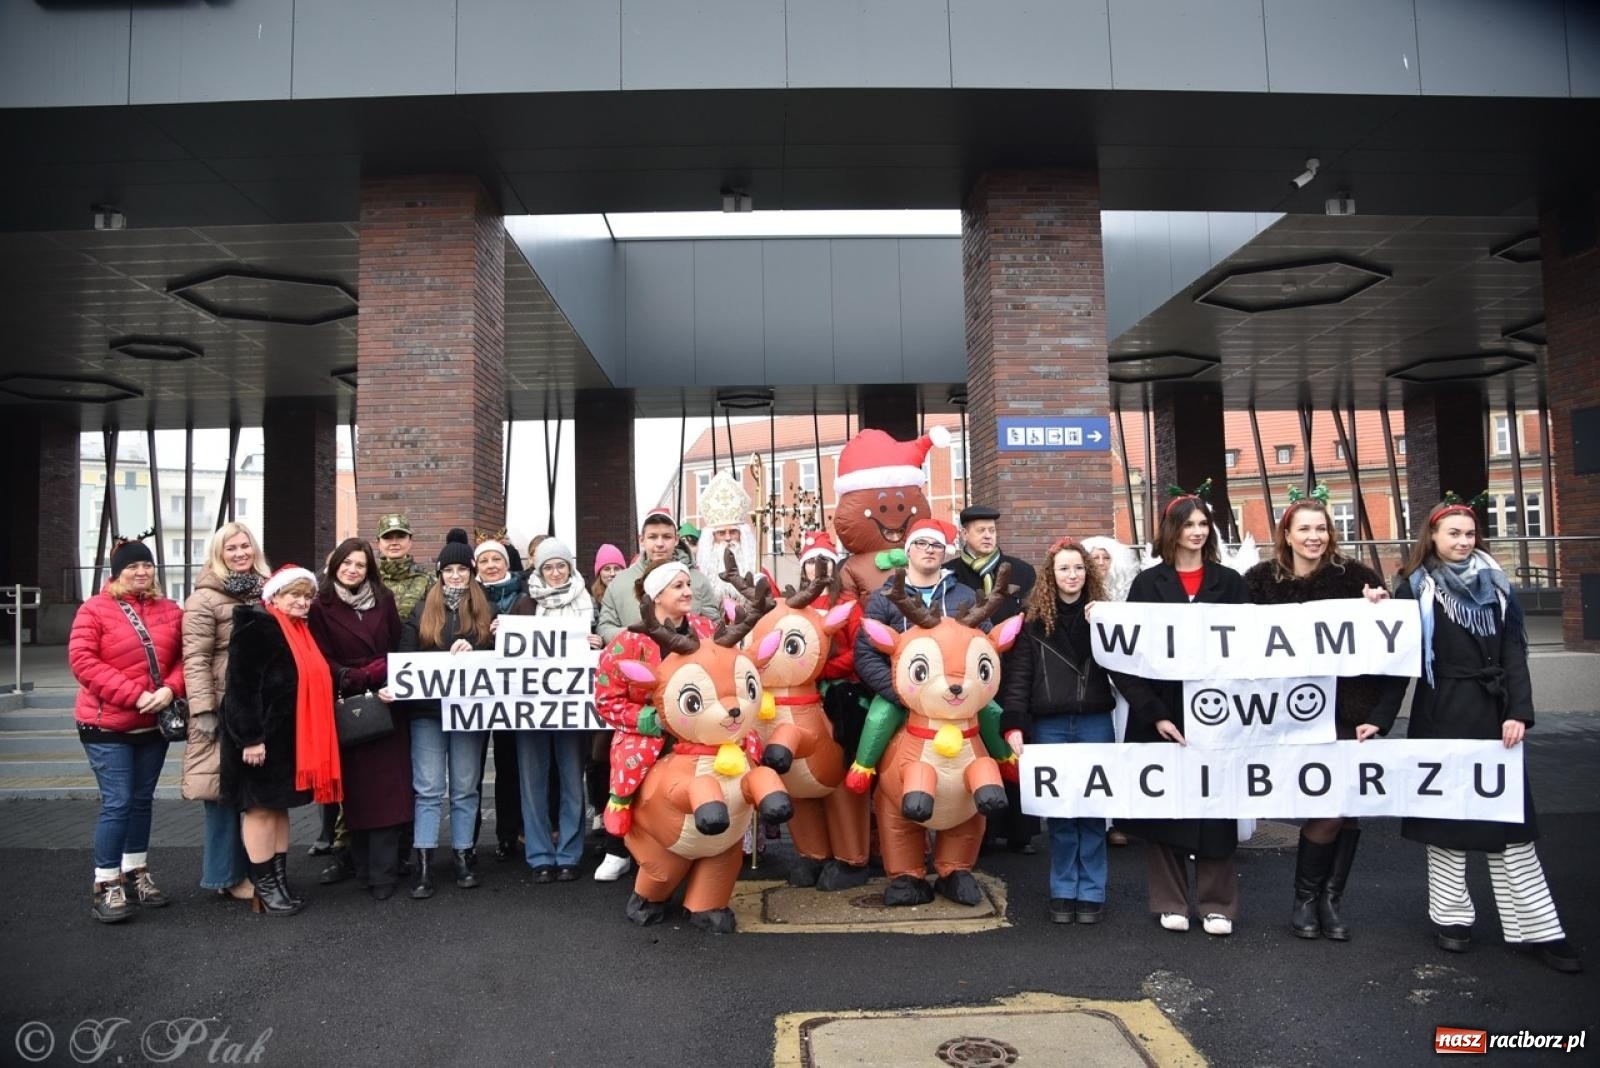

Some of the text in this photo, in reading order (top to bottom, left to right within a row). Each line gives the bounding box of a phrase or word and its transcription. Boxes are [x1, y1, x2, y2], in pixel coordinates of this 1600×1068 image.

[503, 630, 567, 658] DNI
[1096, 619, 1404, 658] WITAMY
[394, 662, 596, 699] ŚWIATECZ
[1034, 762, 1507, 799] RACIBORZU
